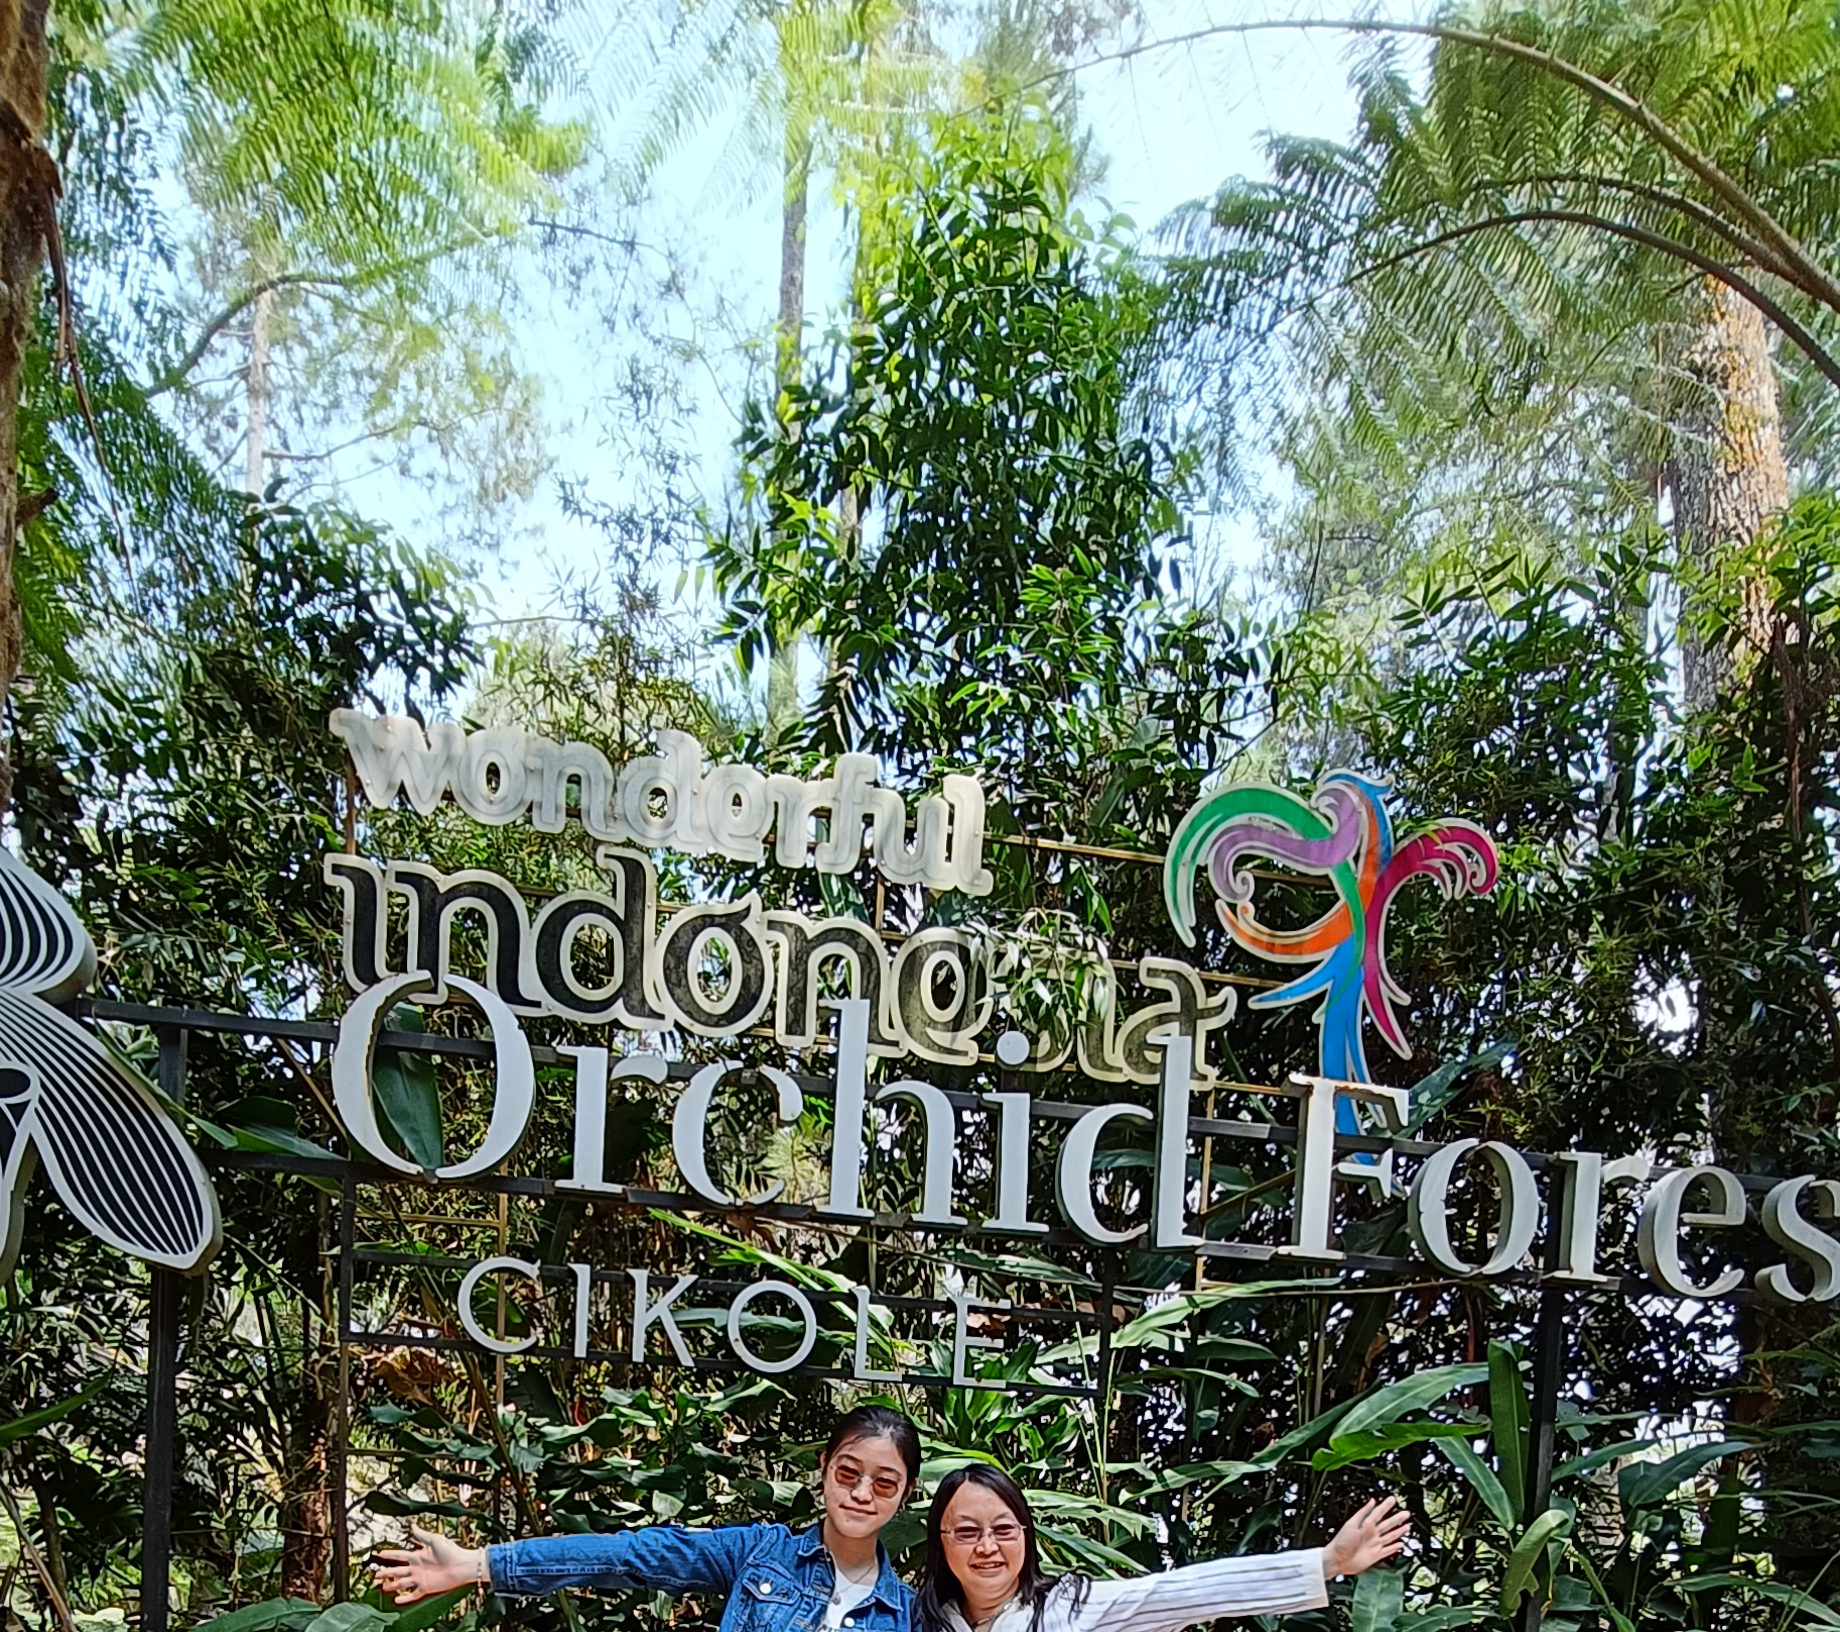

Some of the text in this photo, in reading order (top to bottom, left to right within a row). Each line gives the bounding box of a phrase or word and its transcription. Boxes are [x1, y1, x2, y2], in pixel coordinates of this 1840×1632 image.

[329, 707, 994, 896] wonderful
[331, 970, 1204, 1251] Orchid
[457, 1256, 1012, 1389] CIKOLE
